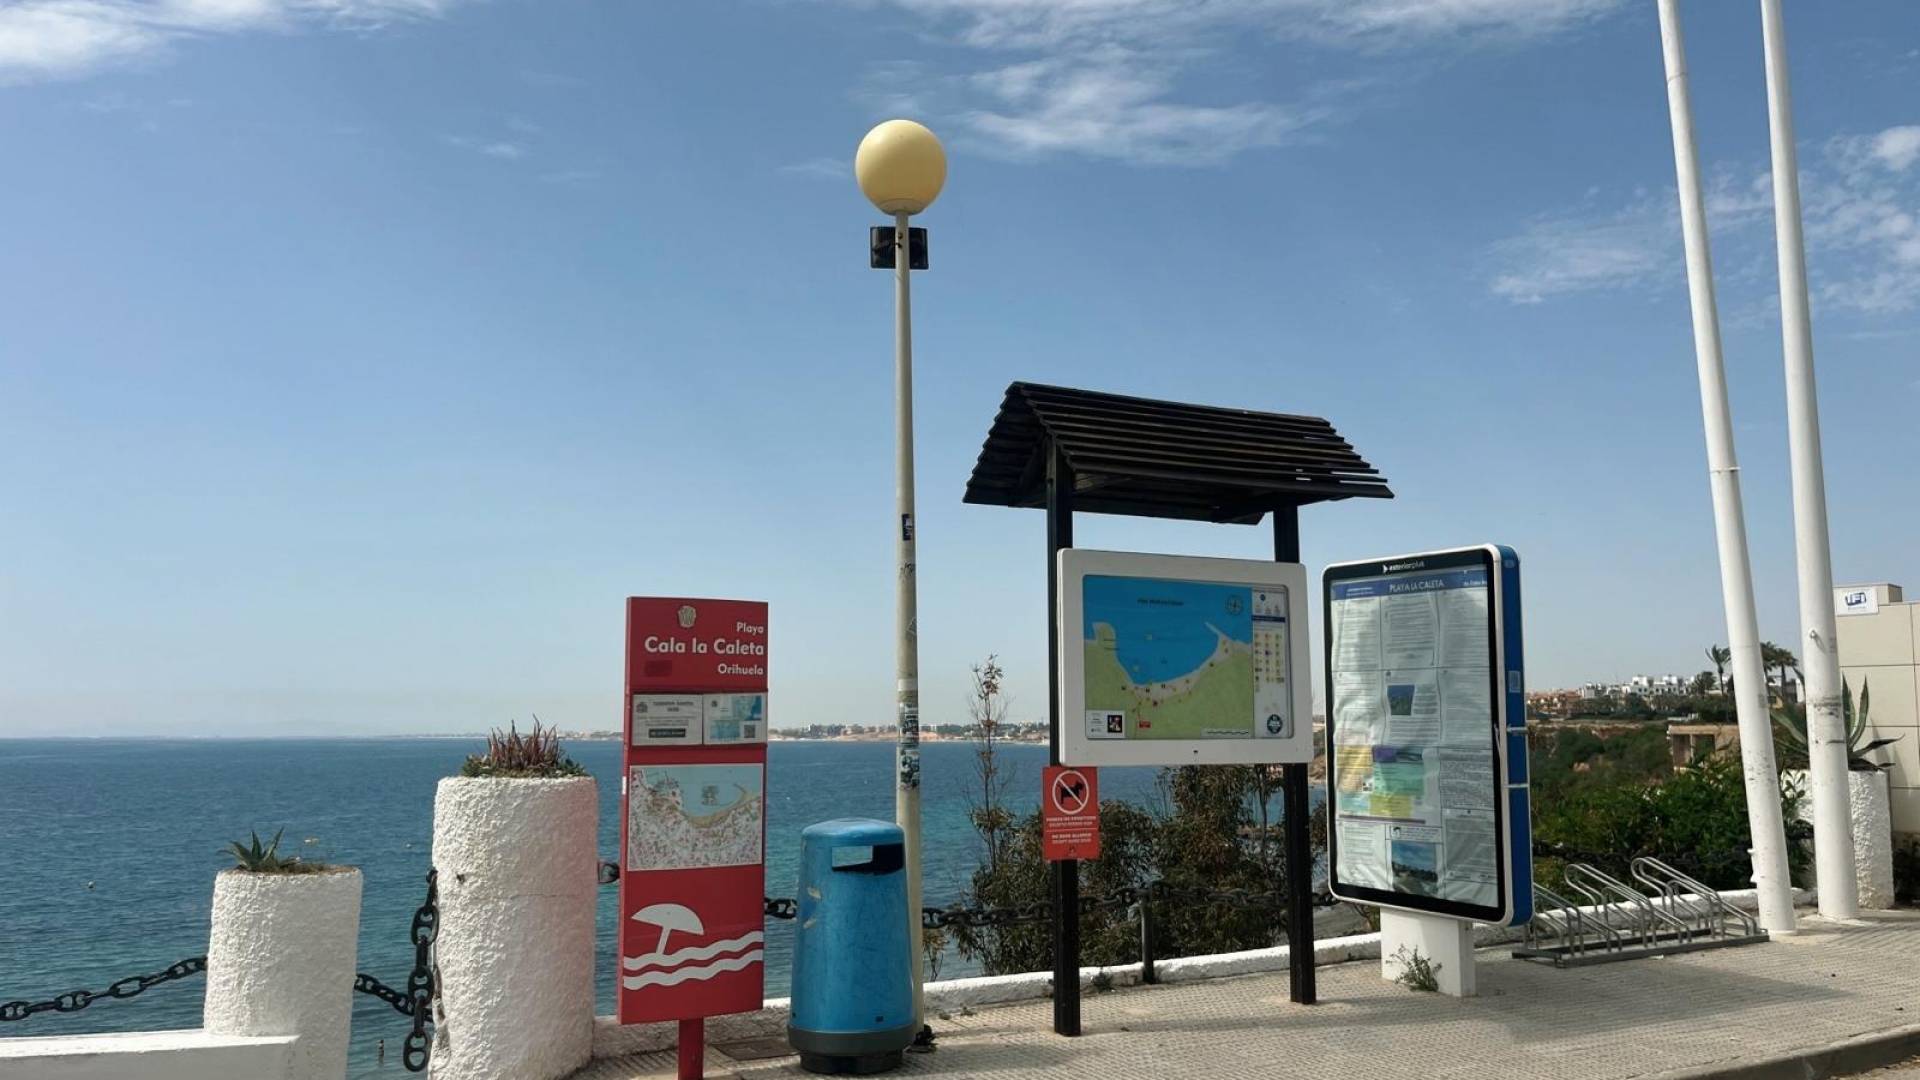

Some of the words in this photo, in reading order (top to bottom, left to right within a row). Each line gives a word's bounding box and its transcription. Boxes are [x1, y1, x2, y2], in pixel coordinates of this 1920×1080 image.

[1389, 583, 1410, 593] PLAYA
[1410, 581, 1418, 591] LA
[1419, 579, 1445, 590] CALETA
[736, 621, 764, 636] Playa
[644, 636, 686, 653] Cala
[692, 637, 708, 654] la
[713, 638, 764, 655] Caleta
[717, 663, 764, 676] Orihuela
